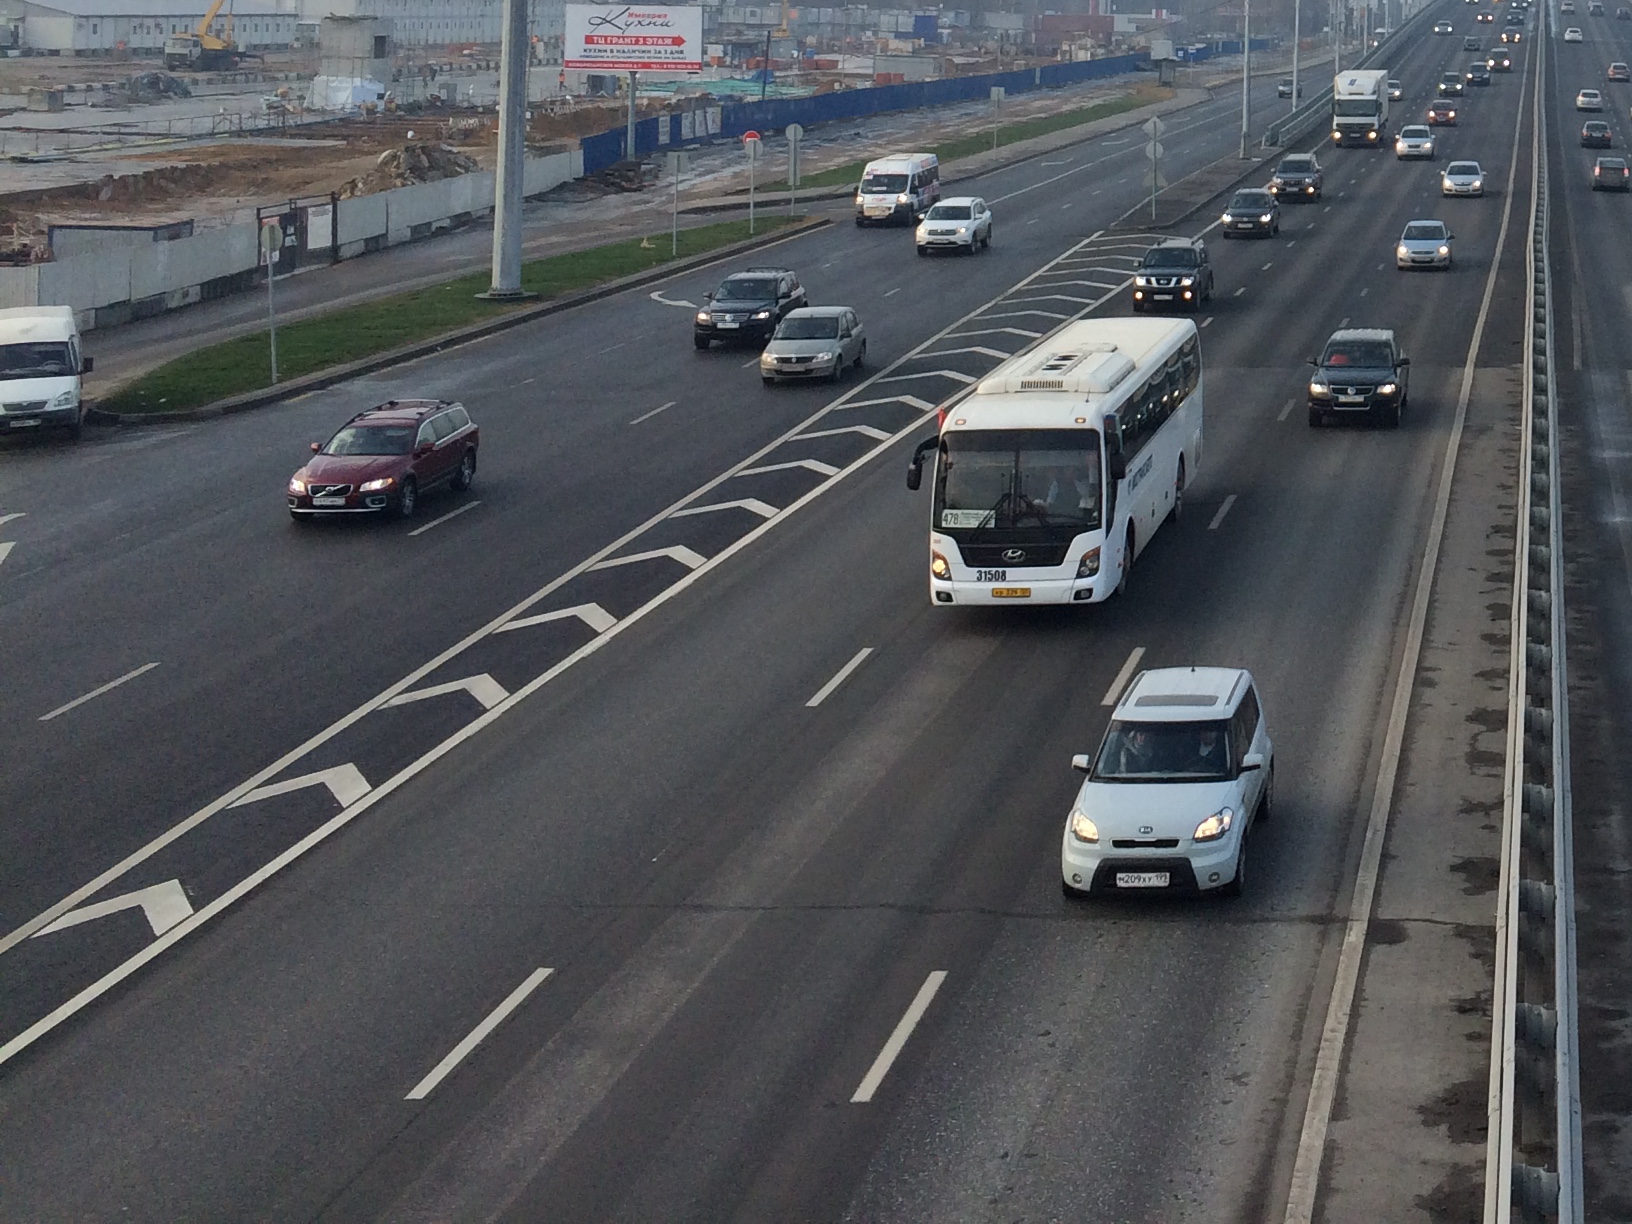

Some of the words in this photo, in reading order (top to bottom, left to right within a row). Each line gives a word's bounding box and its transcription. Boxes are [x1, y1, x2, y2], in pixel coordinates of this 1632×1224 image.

[588, 7, 676, 35] Кухни
[627, 11, 668, 20] Империя
[593, 36, 605, 45] ТЦ
[607, 36, 637, 45] ГРАНТ
[645, 37, 673, 45] ЭТАЖ
[943, 512, 959, 525] 478
[976, 569, 1007, 582] 31508
